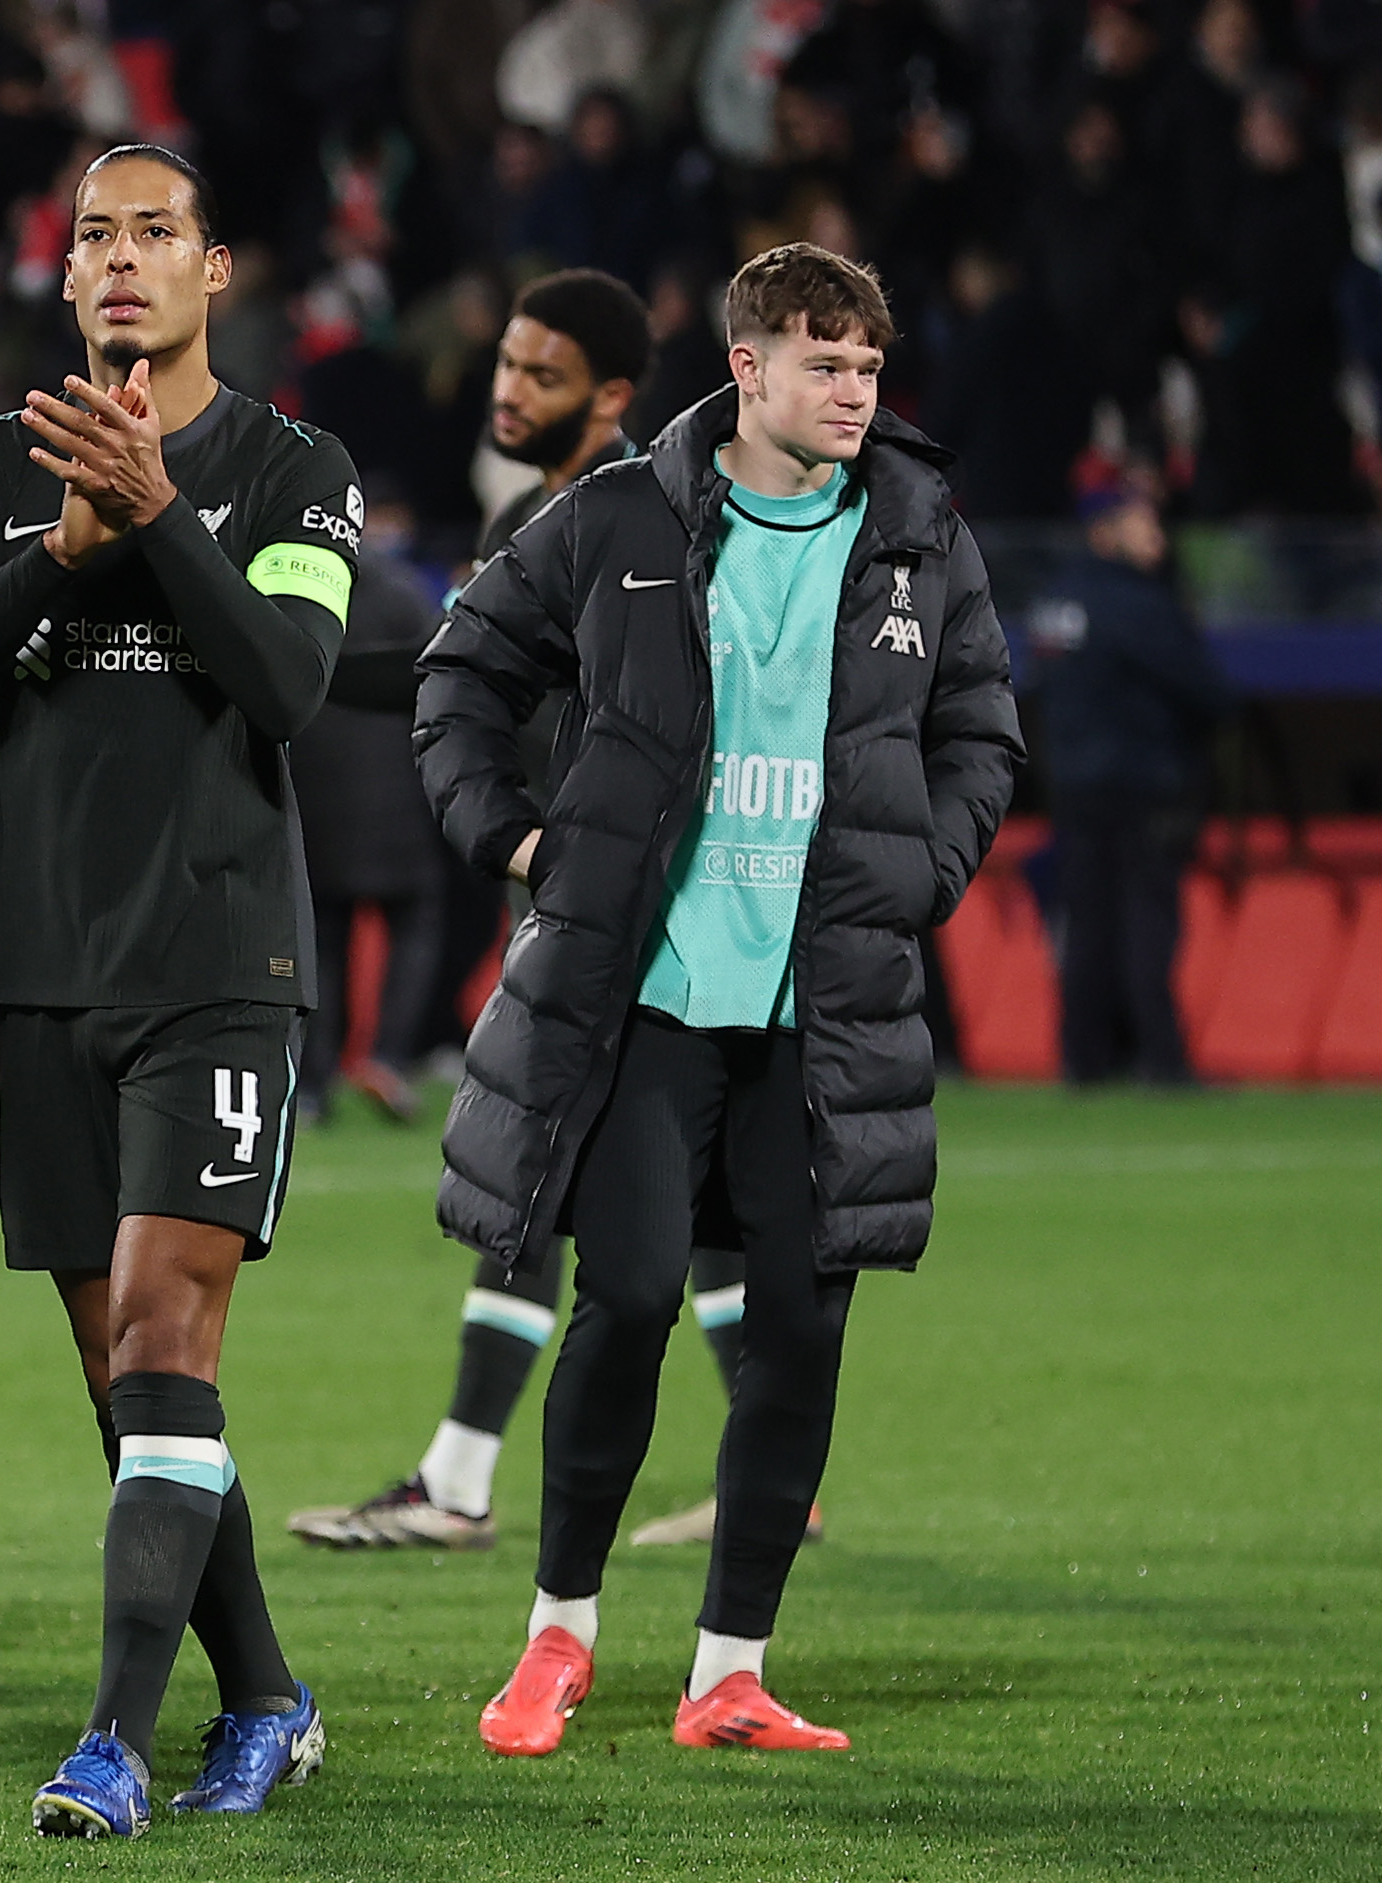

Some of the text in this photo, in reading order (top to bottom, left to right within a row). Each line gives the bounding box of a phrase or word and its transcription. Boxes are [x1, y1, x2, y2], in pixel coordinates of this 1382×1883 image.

[890, 594, 913, 611] LFC
[870, 614, 926, 658] AXA
[214, 1068, 262, 1164] 4
